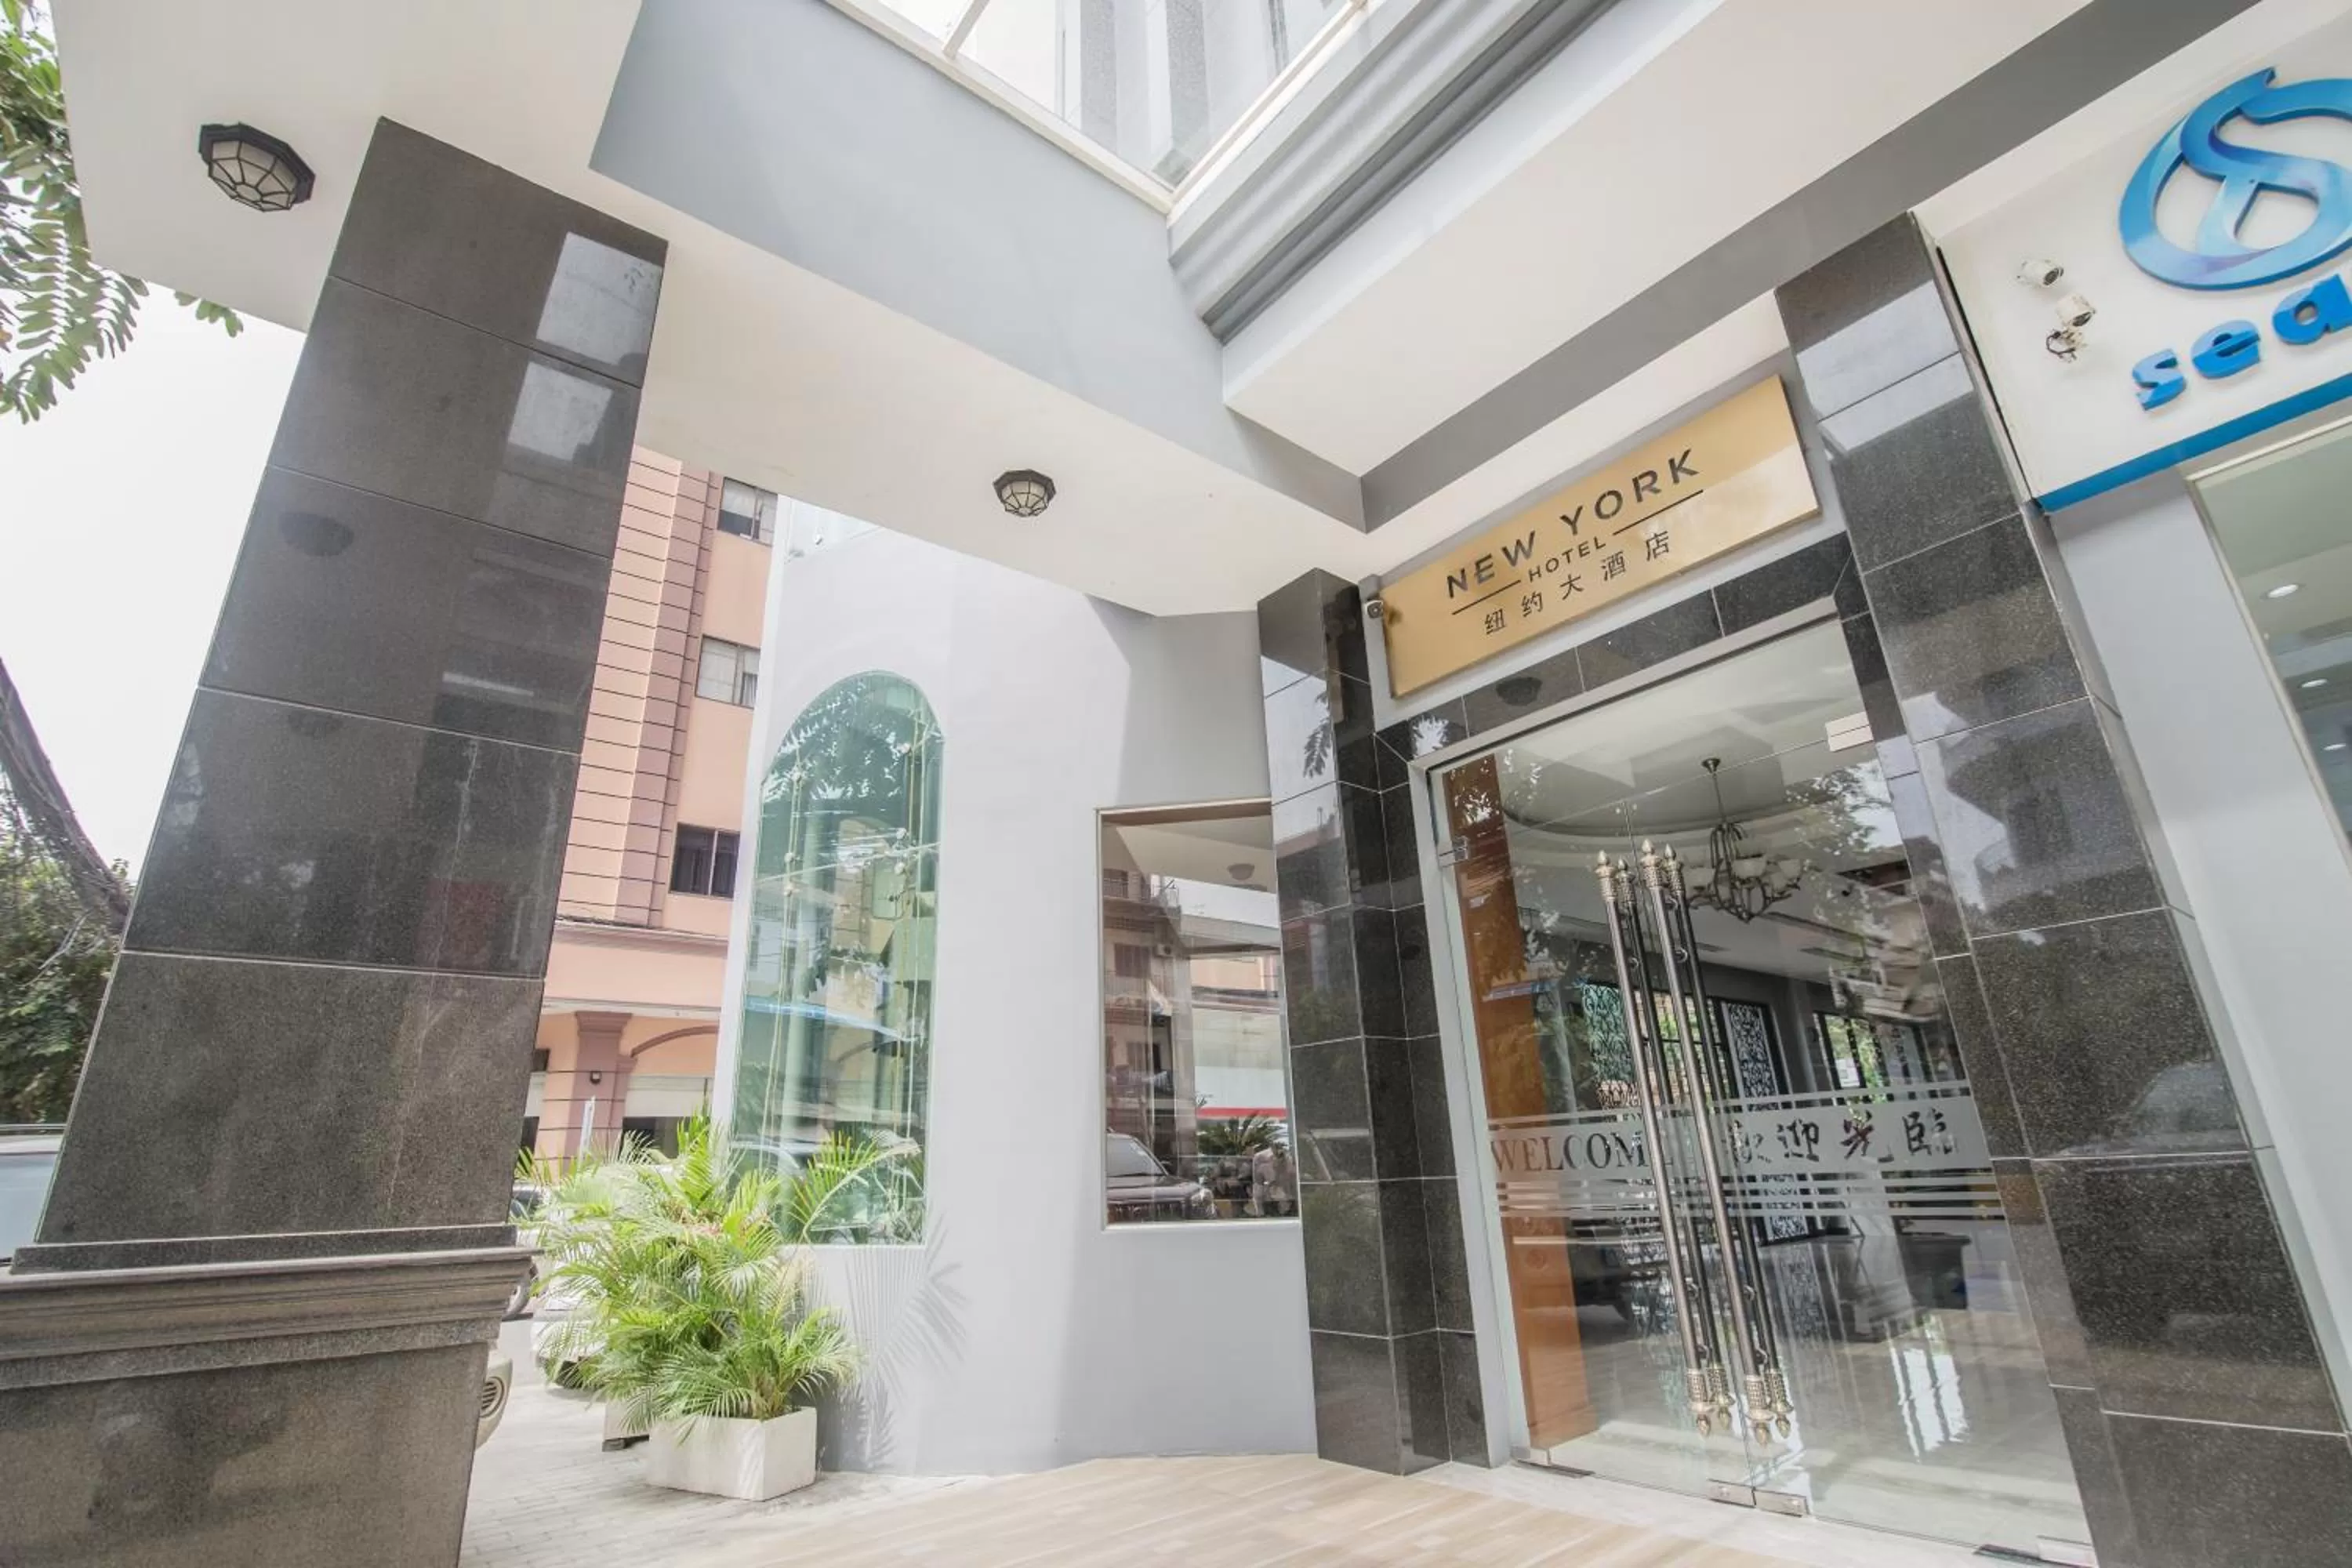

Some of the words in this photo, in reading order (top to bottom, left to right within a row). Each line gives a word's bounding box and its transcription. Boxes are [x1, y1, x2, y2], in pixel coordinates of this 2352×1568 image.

[2132, 273, 2352, 412] sea
[1445, 530, 1537, 599] NEW
[1559, 448, 1700, 536] YORK
[1528, 535, 1607, 583] HOTEL
[1483, 530, 1670, 636] 纽约大酒店
[1490, 1131, 1674, 1174] WELCOM
